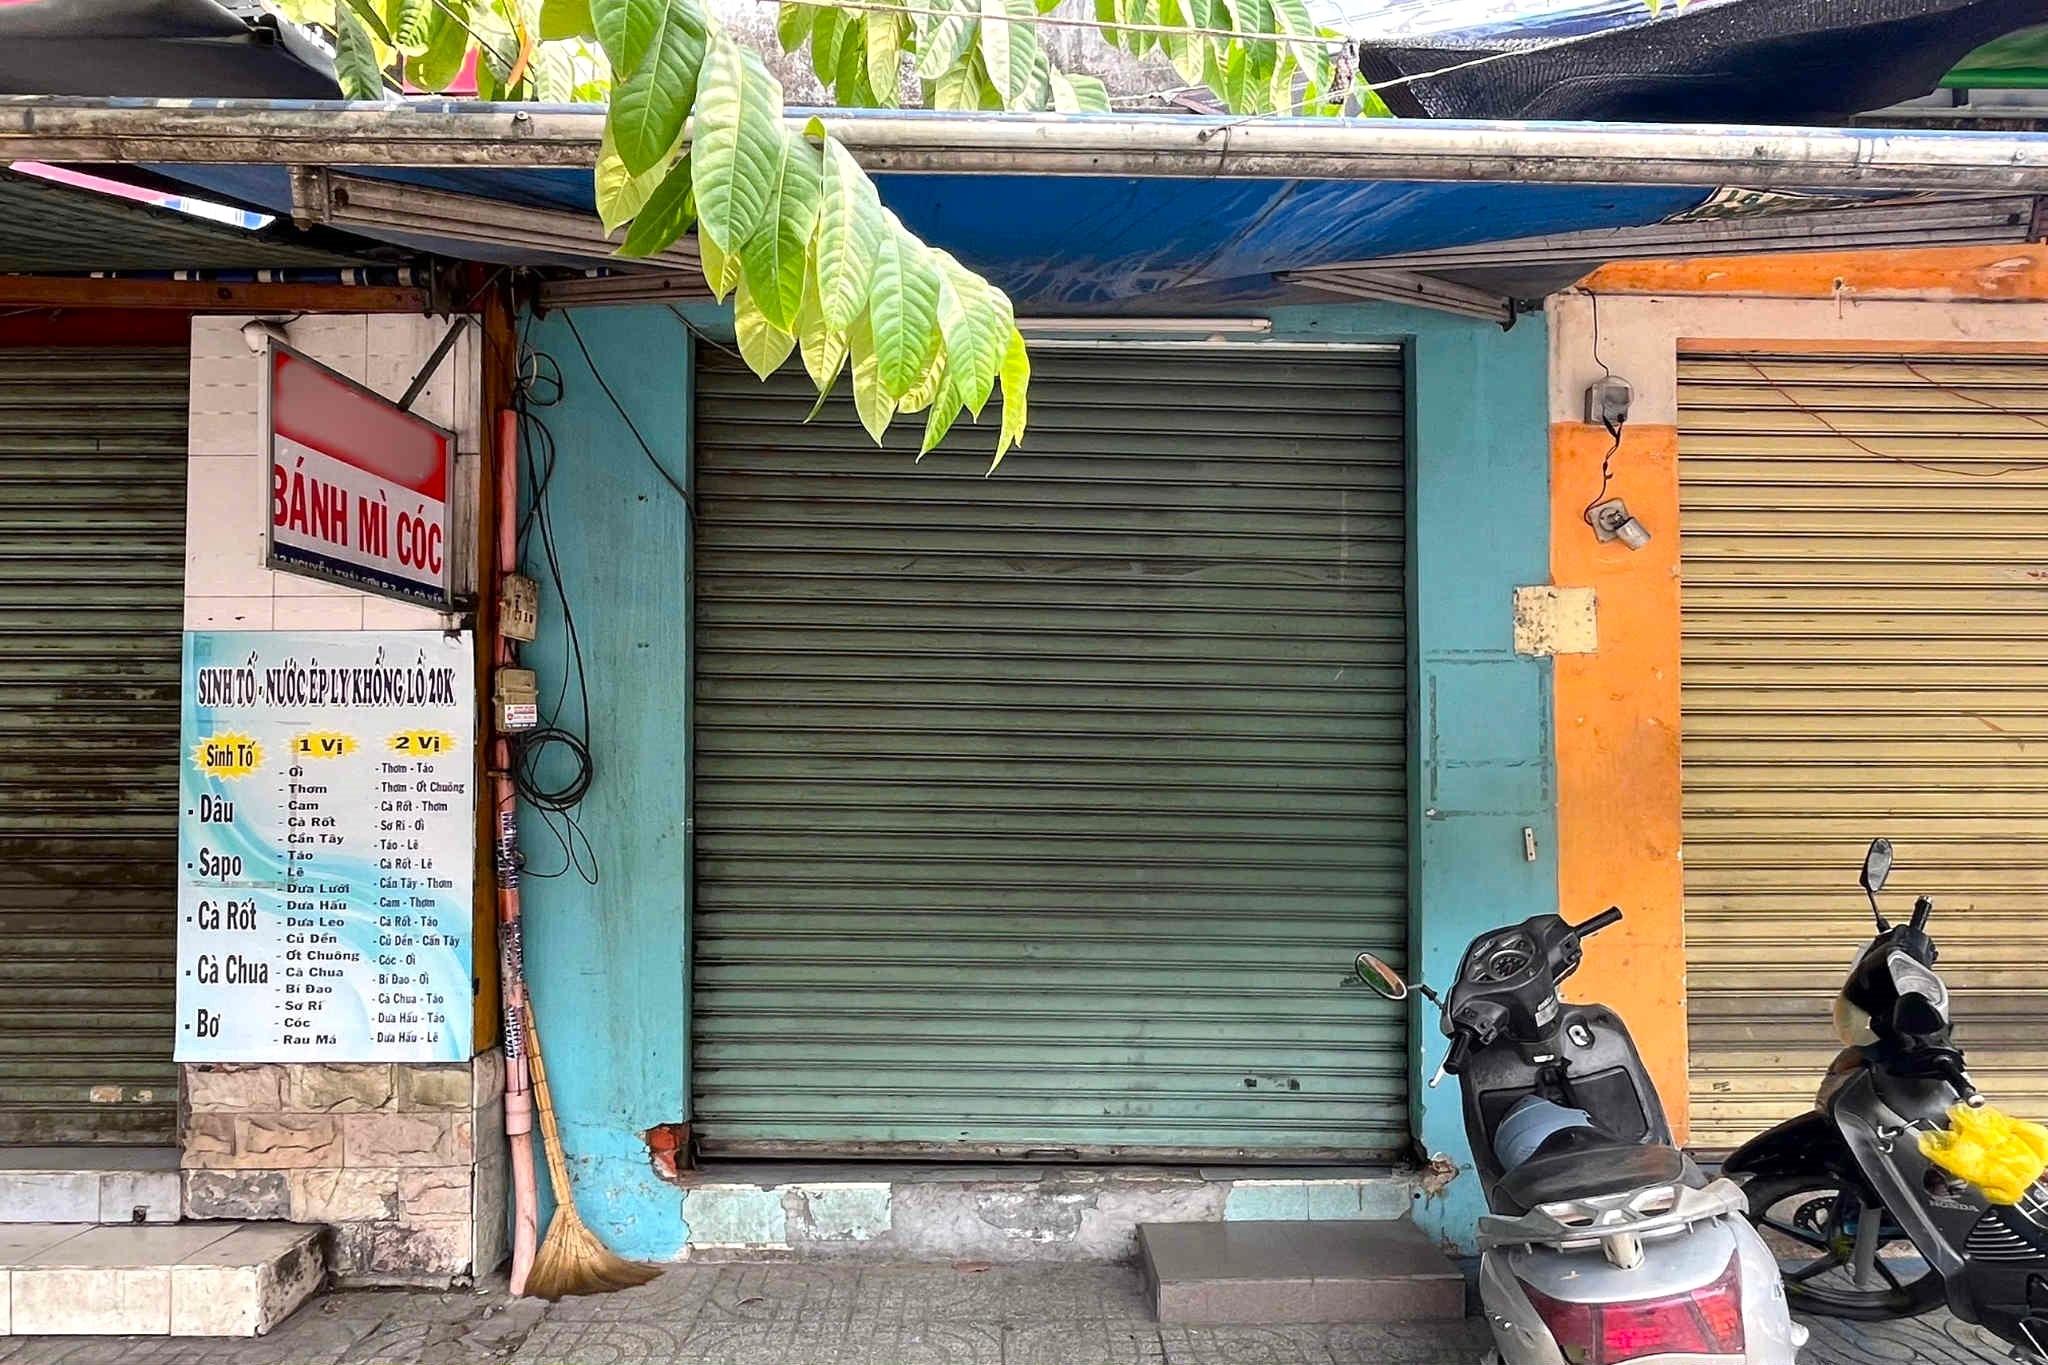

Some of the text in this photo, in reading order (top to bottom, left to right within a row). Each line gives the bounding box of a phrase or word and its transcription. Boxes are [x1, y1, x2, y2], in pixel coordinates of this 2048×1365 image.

[274, 456, 442, 574] BÁNH MÌ CÓC
[199, 646, 454, 704] SINH TỐ NƯỚC ÉP LY KHỔNG LỒ 20K
[206, 741, 256, 767] Sinh Tố
[300, 739, 343, 754] 1 Vị
[395, 737, 440, 752] 2 Vị
[200, 794, 233, 823] Dâu
[288, 800, 319, 811] Cam
[199, 848, 242, 882] Sapo
[199, 898, 257, 930] Cà Rốt
[380, 897, 400, 908] Cam
[319, 917, 345, 927] Leo
[197, 954, 268, 984] Cà Chua
[308, 967, 344, 978] Chua
[197, 1009, 221, 1037] Bơ
[283, 1035, 311, 1045] Rau
